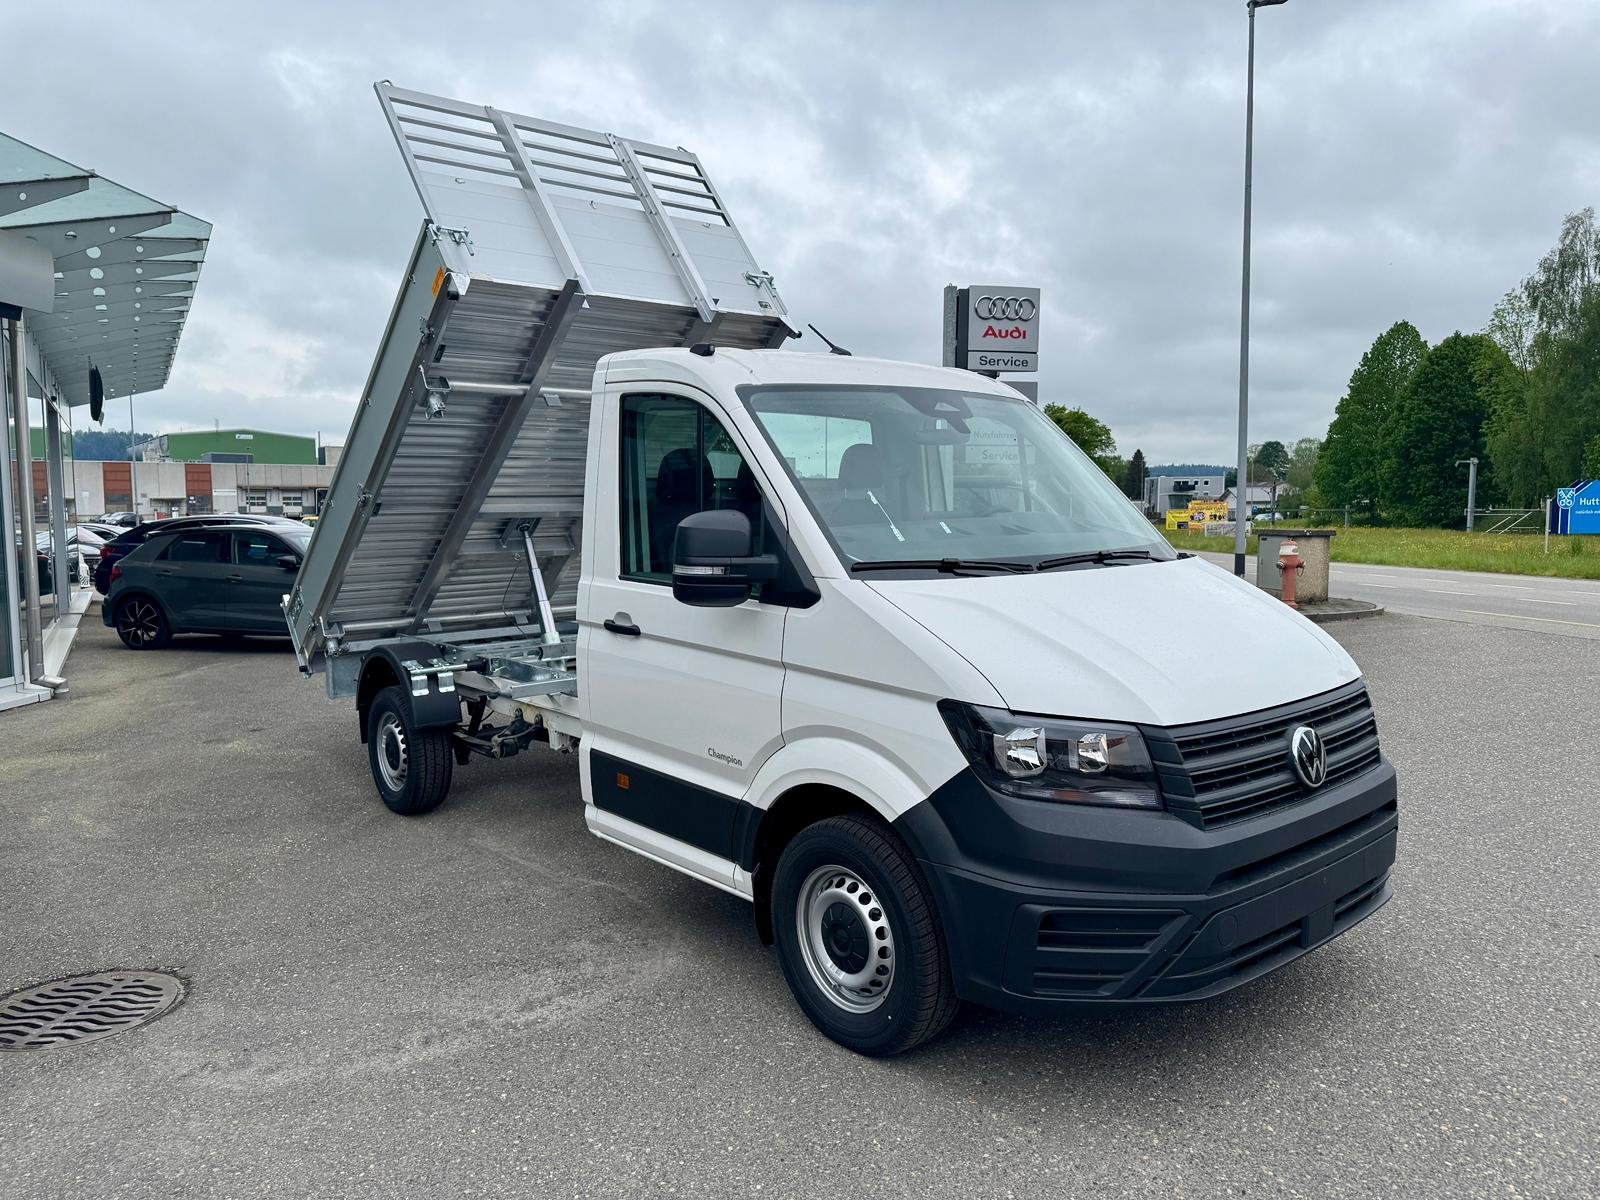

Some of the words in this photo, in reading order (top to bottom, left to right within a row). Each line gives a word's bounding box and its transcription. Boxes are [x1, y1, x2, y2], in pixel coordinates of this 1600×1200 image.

[982, 326, 1027, 339] Audi
[979, 355, 1029, 367] Service
[973, 430, 1017, 440] Nutzfahrze
[1579, 497, 1600, 506] Hutt
[707, 747, 743, 767] Champion
